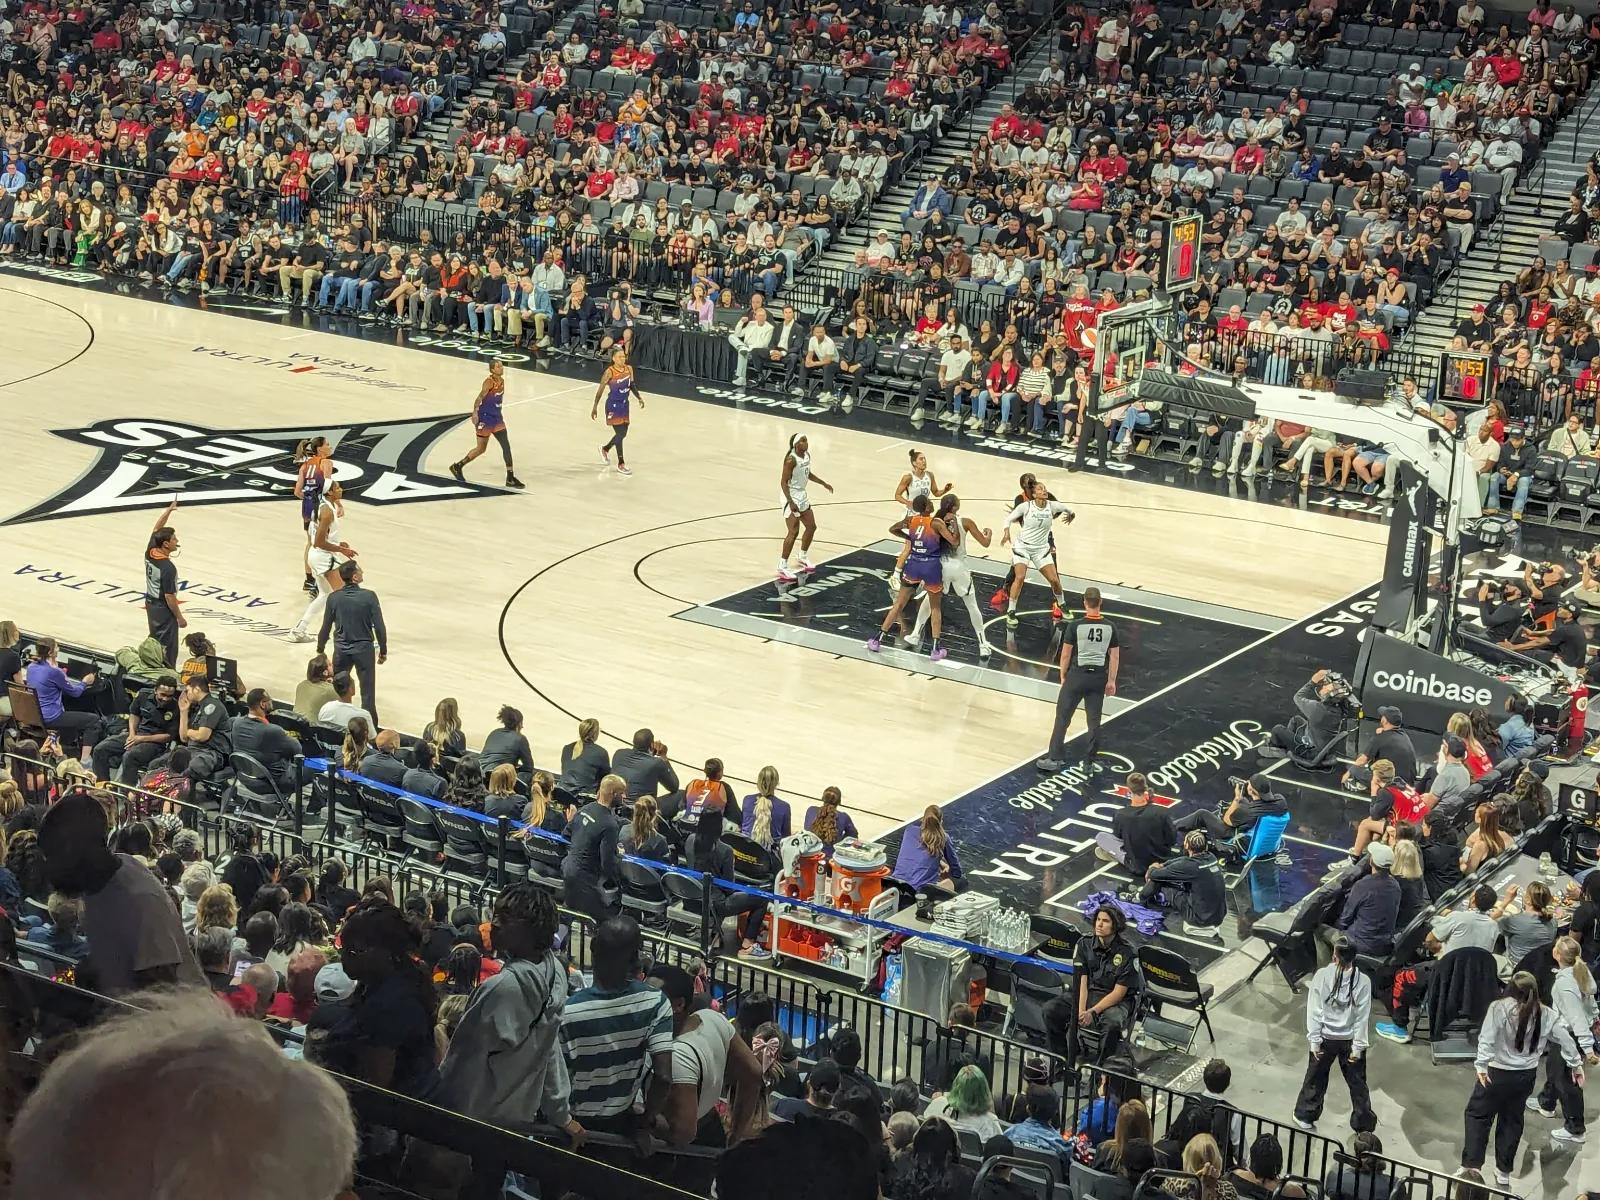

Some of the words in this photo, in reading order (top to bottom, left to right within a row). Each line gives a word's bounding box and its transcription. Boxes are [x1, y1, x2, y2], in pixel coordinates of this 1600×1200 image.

[192, 346, 293, 369] ULTRA
[408, 336, 530, 362] Google
[288, 352, 387, 373] ARENA
[81, 421, 480, 499] ACES
[121, 452, 233, 482] VEGAS
[305, 464, 317, 479] 11
[915, 525, 925, 539] 4
[1037, 518, 1044, 527] 7
[178, 580, 280, 608] AREN
[766, 572, 864, 602] WNBA
[1087, 628, 1103, 642] 43
[216, 660, 227, 677] F
[1373, 669, 1493, 706] coinbase
[1148, 720, 1272, 794] Michelob
[693, 789, 711, 805] 3
[1571, 789, 1586, 810] G
[969, 802, 1127, 881] ULTRA
[841, 877, 857, 891] G
